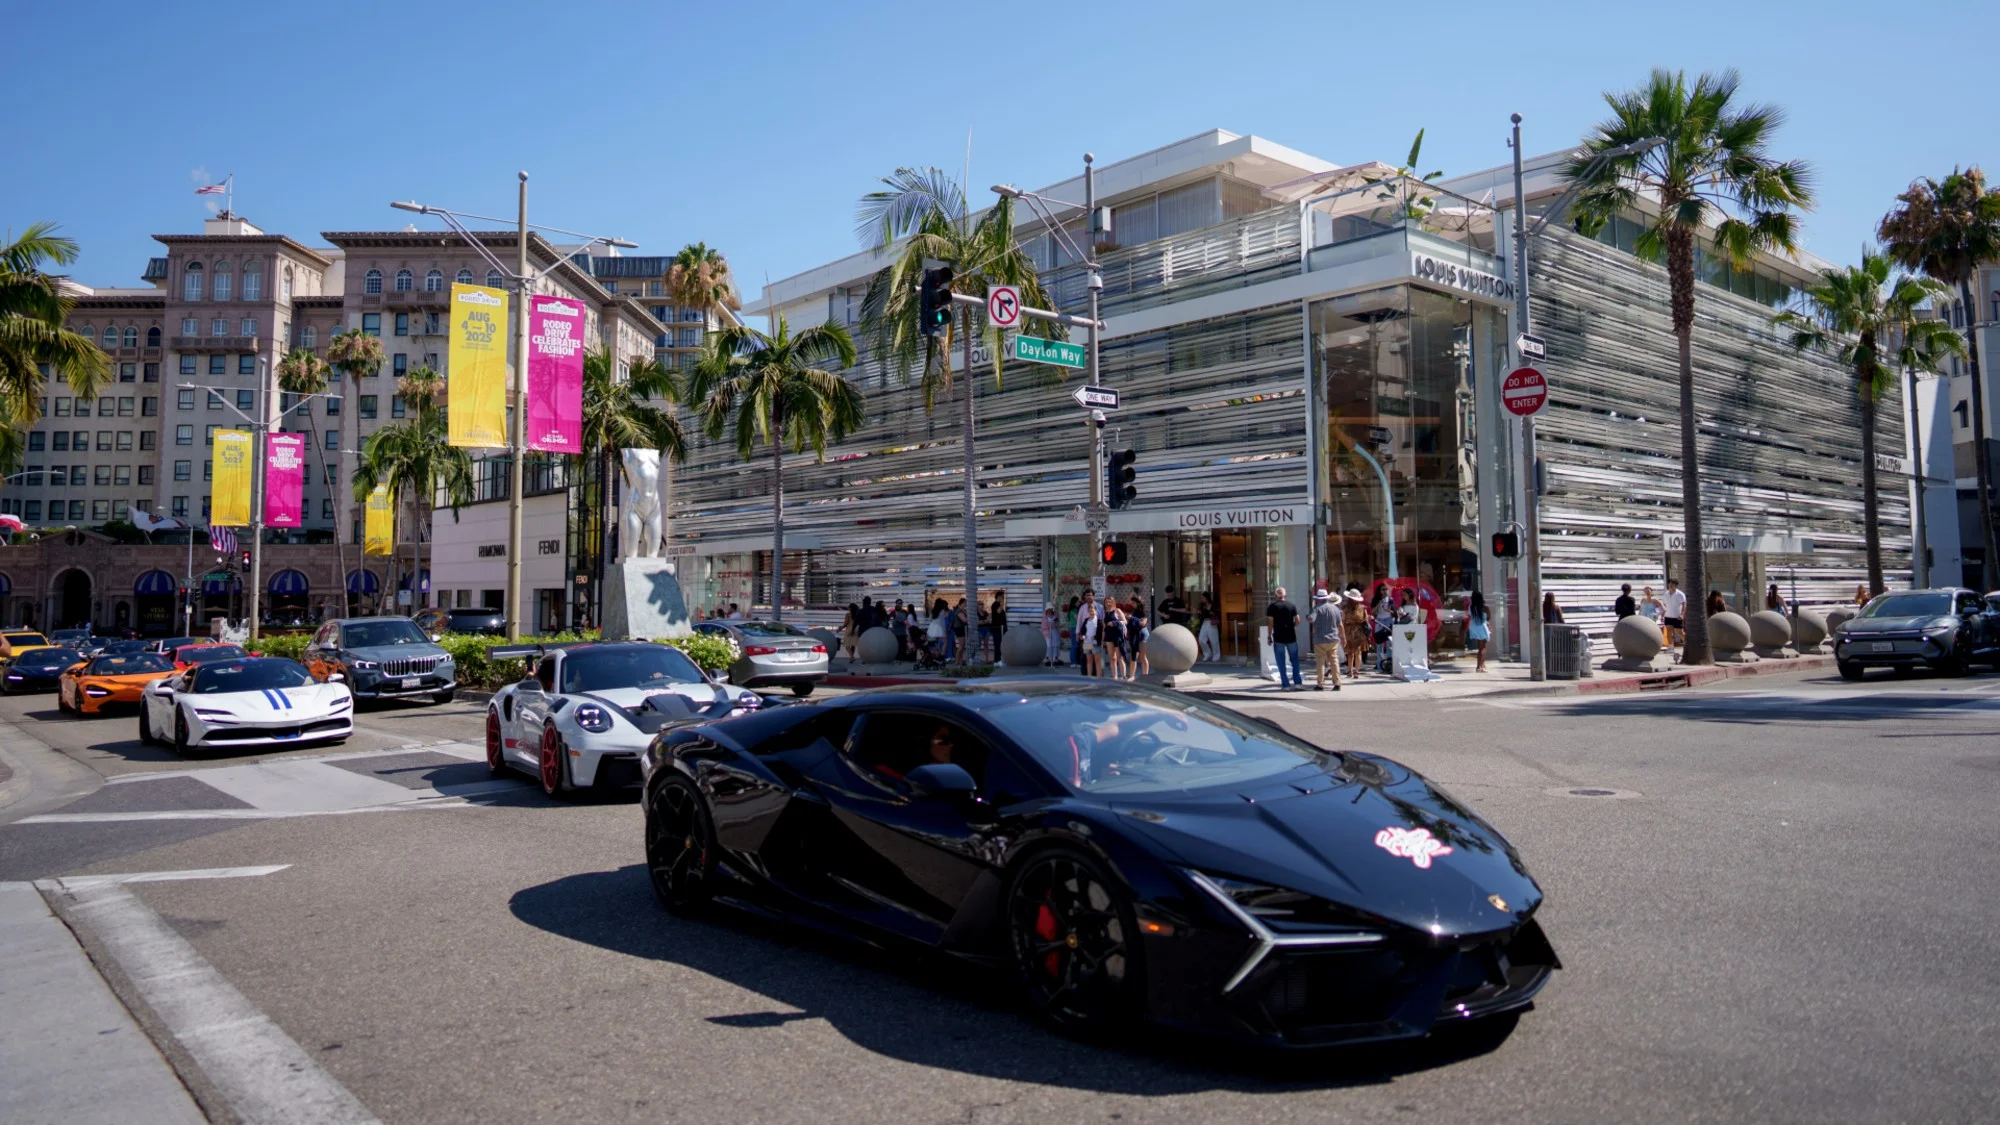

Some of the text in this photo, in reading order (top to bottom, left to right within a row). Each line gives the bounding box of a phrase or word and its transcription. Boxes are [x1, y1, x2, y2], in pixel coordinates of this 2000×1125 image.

[1415, 255, 1514, 300] LOUIS VUITTON
[468, 311, 490, 323] AUG
[543, 319, 572, 330] RODEO
[465, 331, 492, 343] 2025
[544, 328, 570, 338] DRIVE
[532, 335, 581, 349] CELEBRATES
[1524, 340, 1533, 351] ONE
[538, 344, 574, 356] FASHION
[1021, 341, 1058, 359] Dayton
[1060, 348, 1081, 365] Way
[1508, 375, 1540, 387] DO NOT
[1086, 393, 1098, 402] ONE
[1512, 398, 1538, 408] ENTER
[1180, 509, 1294, 527] LOUIS VUITTON
[538, 540, 560, 555] FENDI
[1669, 536, 1736, 549] LOU UITTON
[576, 575, 588, 584] FENDI
